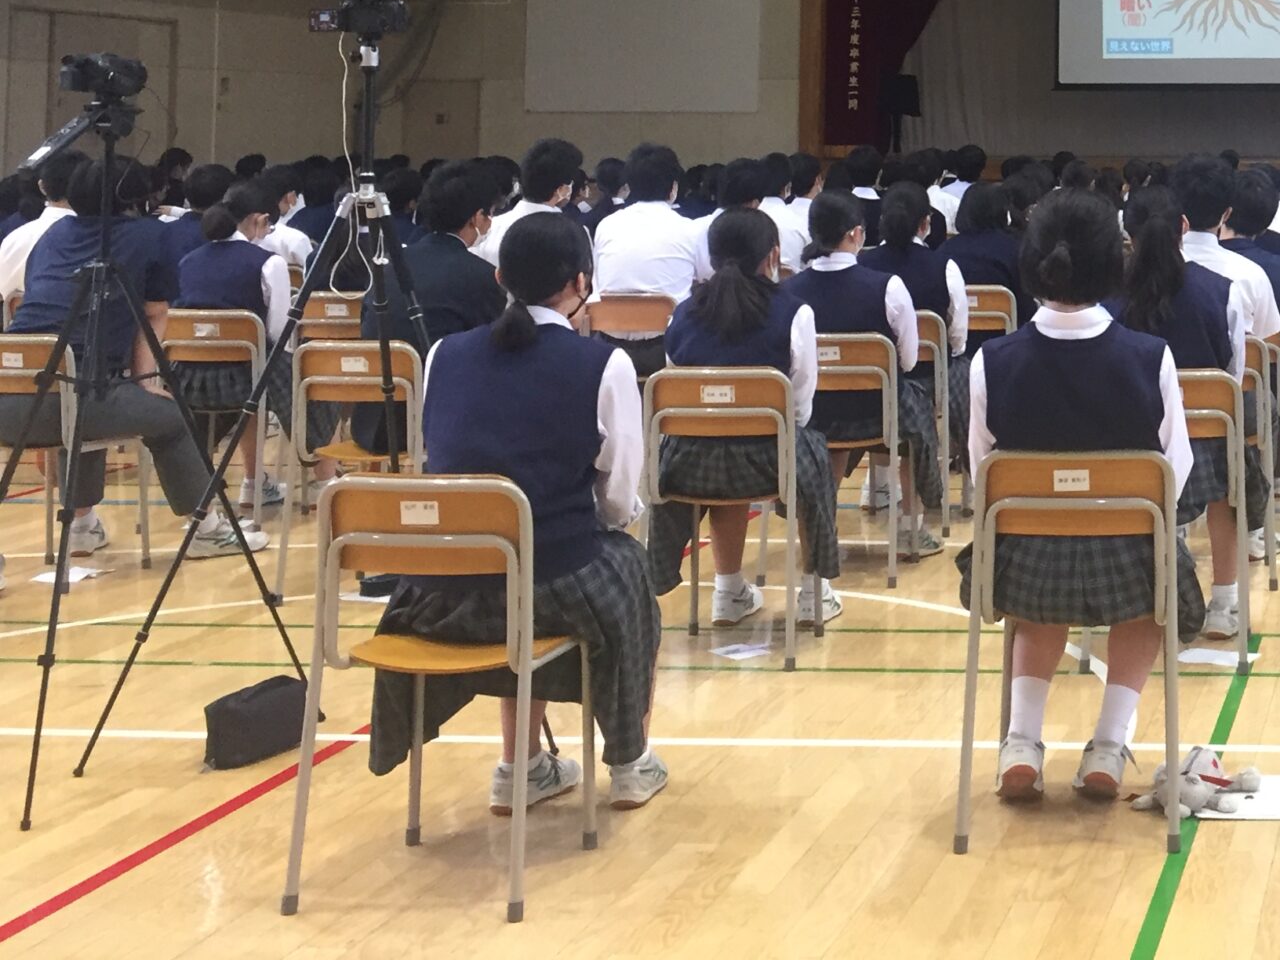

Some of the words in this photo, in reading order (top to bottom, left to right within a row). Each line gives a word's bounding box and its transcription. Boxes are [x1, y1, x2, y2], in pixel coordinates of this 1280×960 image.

[1109, 40, 1171, 52] 見えない世界
